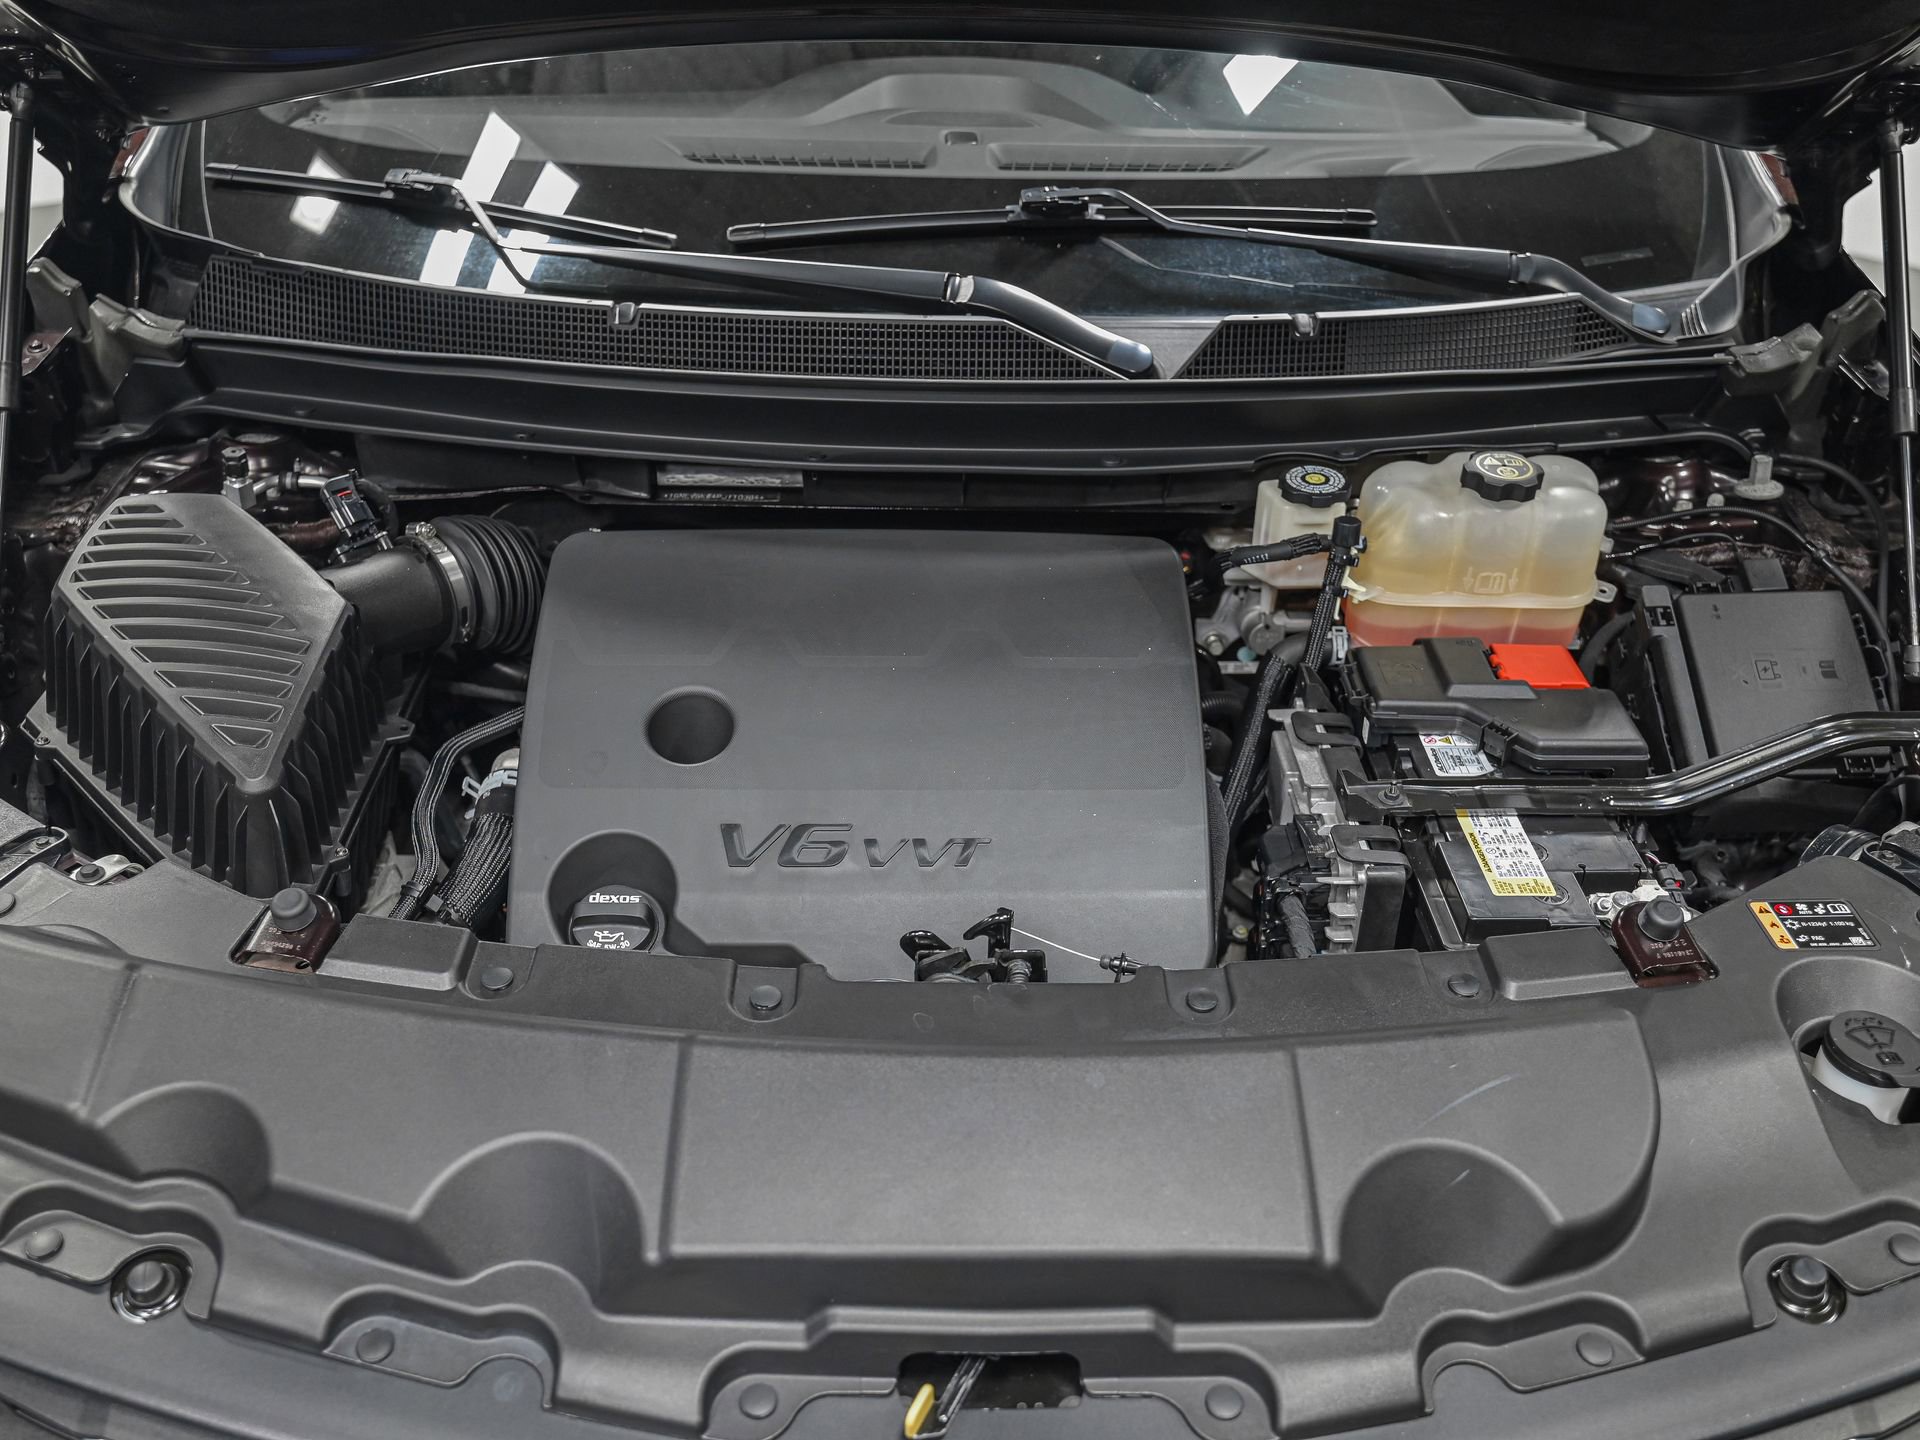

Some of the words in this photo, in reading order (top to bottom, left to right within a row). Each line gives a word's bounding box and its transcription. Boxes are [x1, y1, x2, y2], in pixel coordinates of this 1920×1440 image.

[719, 823, 854, 868] V6
[863, 838, 993, 868] VVT
[588, 892, 642, 904] dexos
